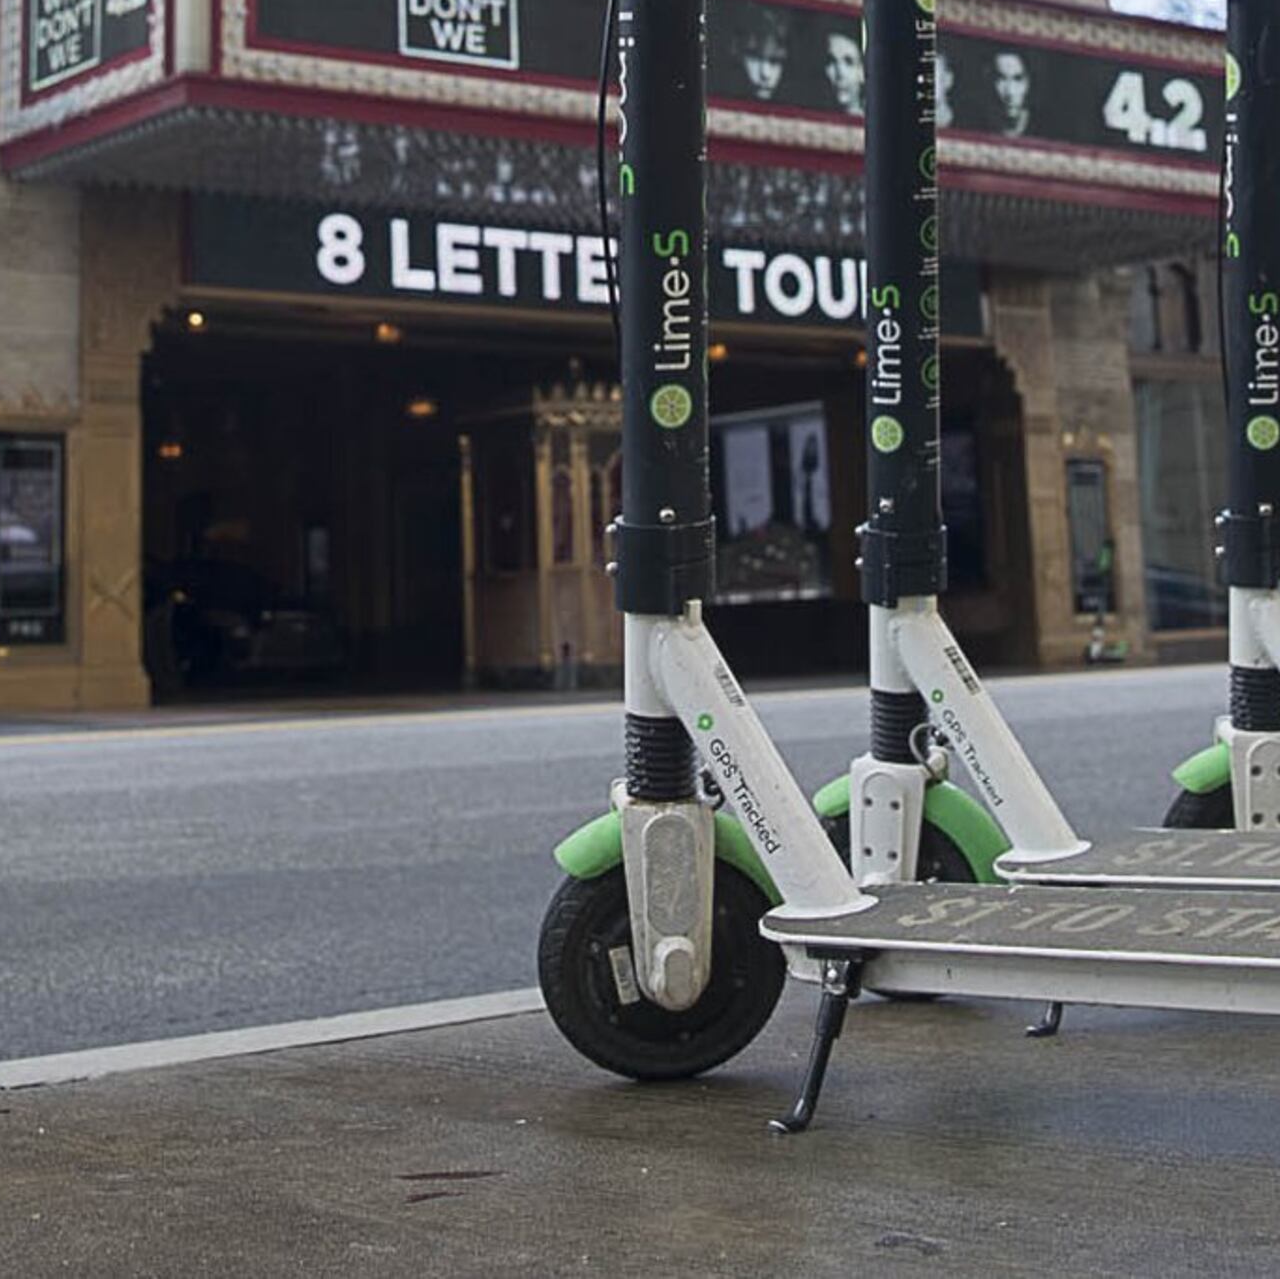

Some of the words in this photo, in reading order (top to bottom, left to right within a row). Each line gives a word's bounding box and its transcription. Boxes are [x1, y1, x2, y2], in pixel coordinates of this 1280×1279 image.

[46, 34, 82, 71] WE
[430, 18, 487, 54] WE
[1103, 71, 1207, 152] 4.2
[317, 213, 366, 285] 8
[390, 218, 620, 304] LETTE
[723, 250, 868, 321] TOU
[709, 738, 738, 779] GPS
[733, 771, 781, 854] Tracked
[1010, 902, 1136, 933] TO
